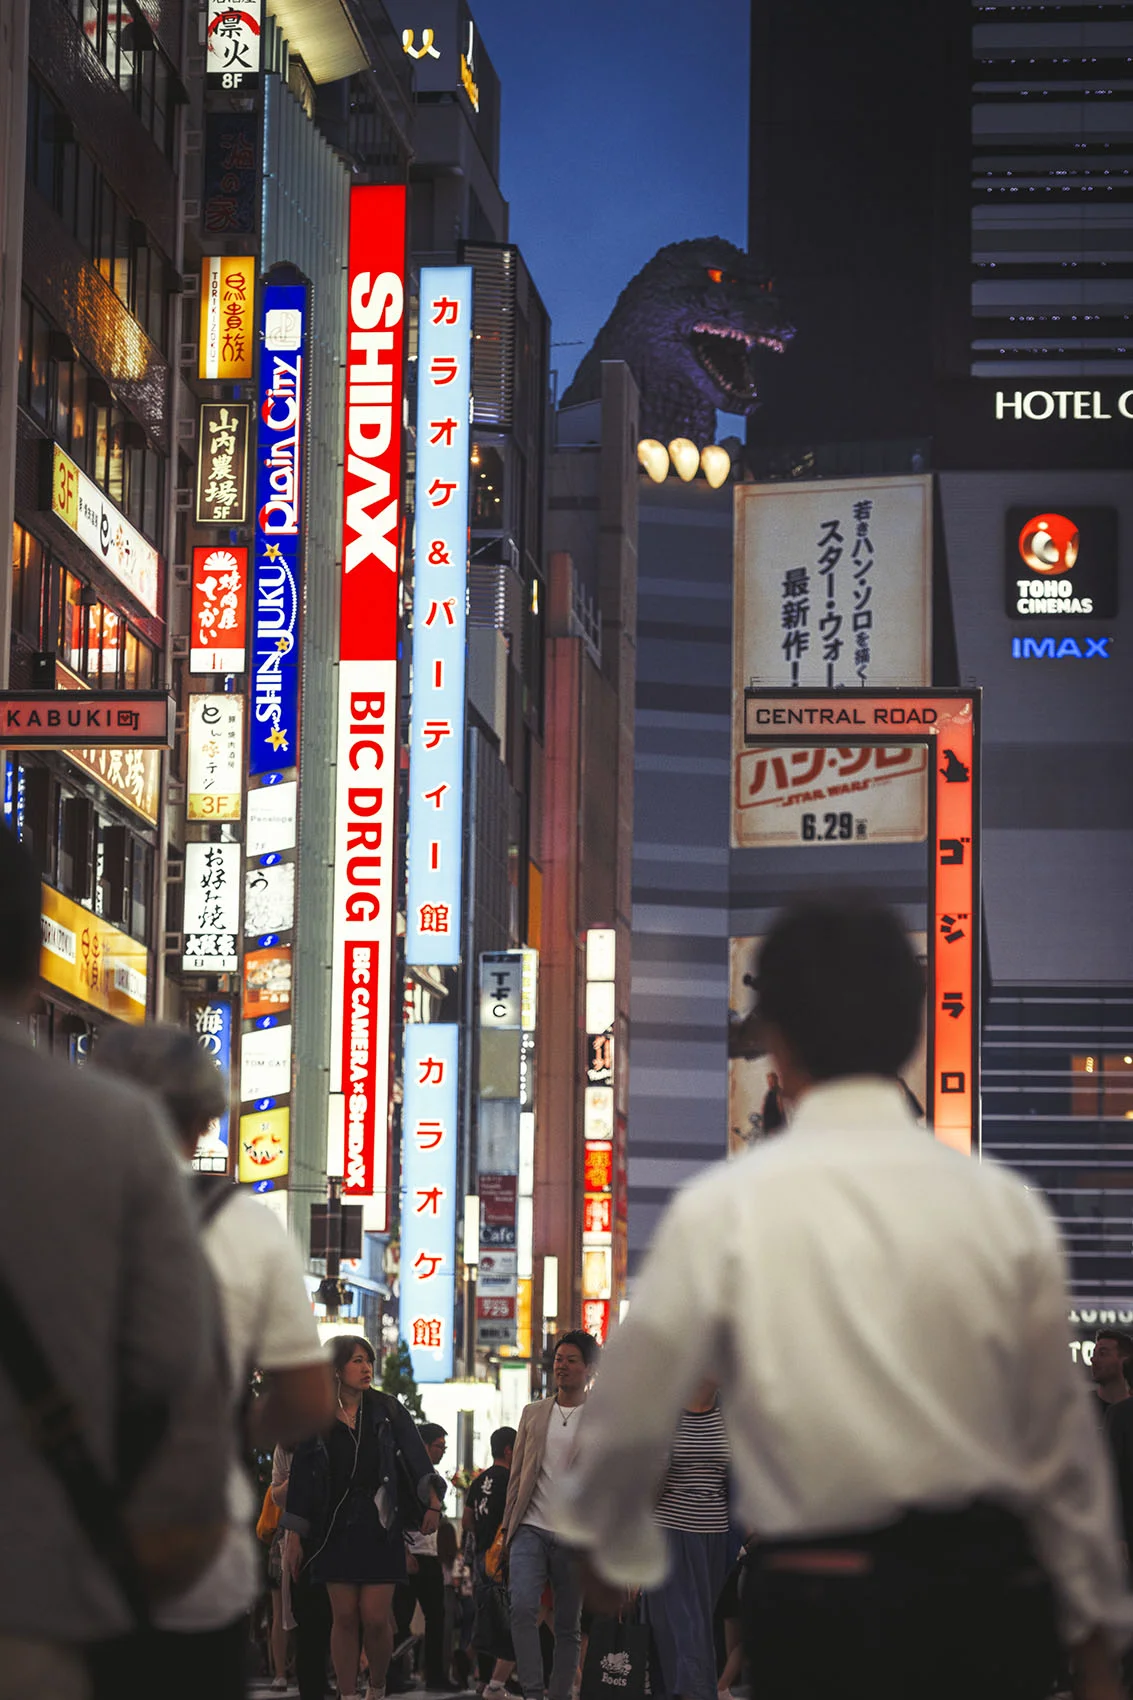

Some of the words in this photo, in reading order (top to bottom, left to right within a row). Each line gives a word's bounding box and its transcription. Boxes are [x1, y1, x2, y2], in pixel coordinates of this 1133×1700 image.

[222, 73, 243, 88] 8F
[996, 390, 1112, 420] HOTEL
[344, 271, 404, 574] SHIDAX
[204, 407, 239, 506] 山内農場
[58, 461, 74, 515] 3F
[213, 507, 230, 520] 5F
[817, 520, 844, 688] スター・ウォー
[1016, 580, 1073, 598] TOHO
[1016, 597, 1094, 614] CINEMAS
[254, 565, 294, 723] SHINJUKU
[1011, 637, 1110, 659] IMAX
[348, 691, 386, 771] BIC
[756, 709, 866, 725] CENTRAL
[874, 709, 938, 725] ROAD
[268, 774, 277, 785] 7
[202, 796, 229, 815] 3F
[802, 811, 854, 841] 6.29
[345, 787, 384, 923] DRUG
[264, 935, 273, 946] 5
[352, 947, 371, 985] BIC
[412, 1056, 446, 1349] カラオケ館
